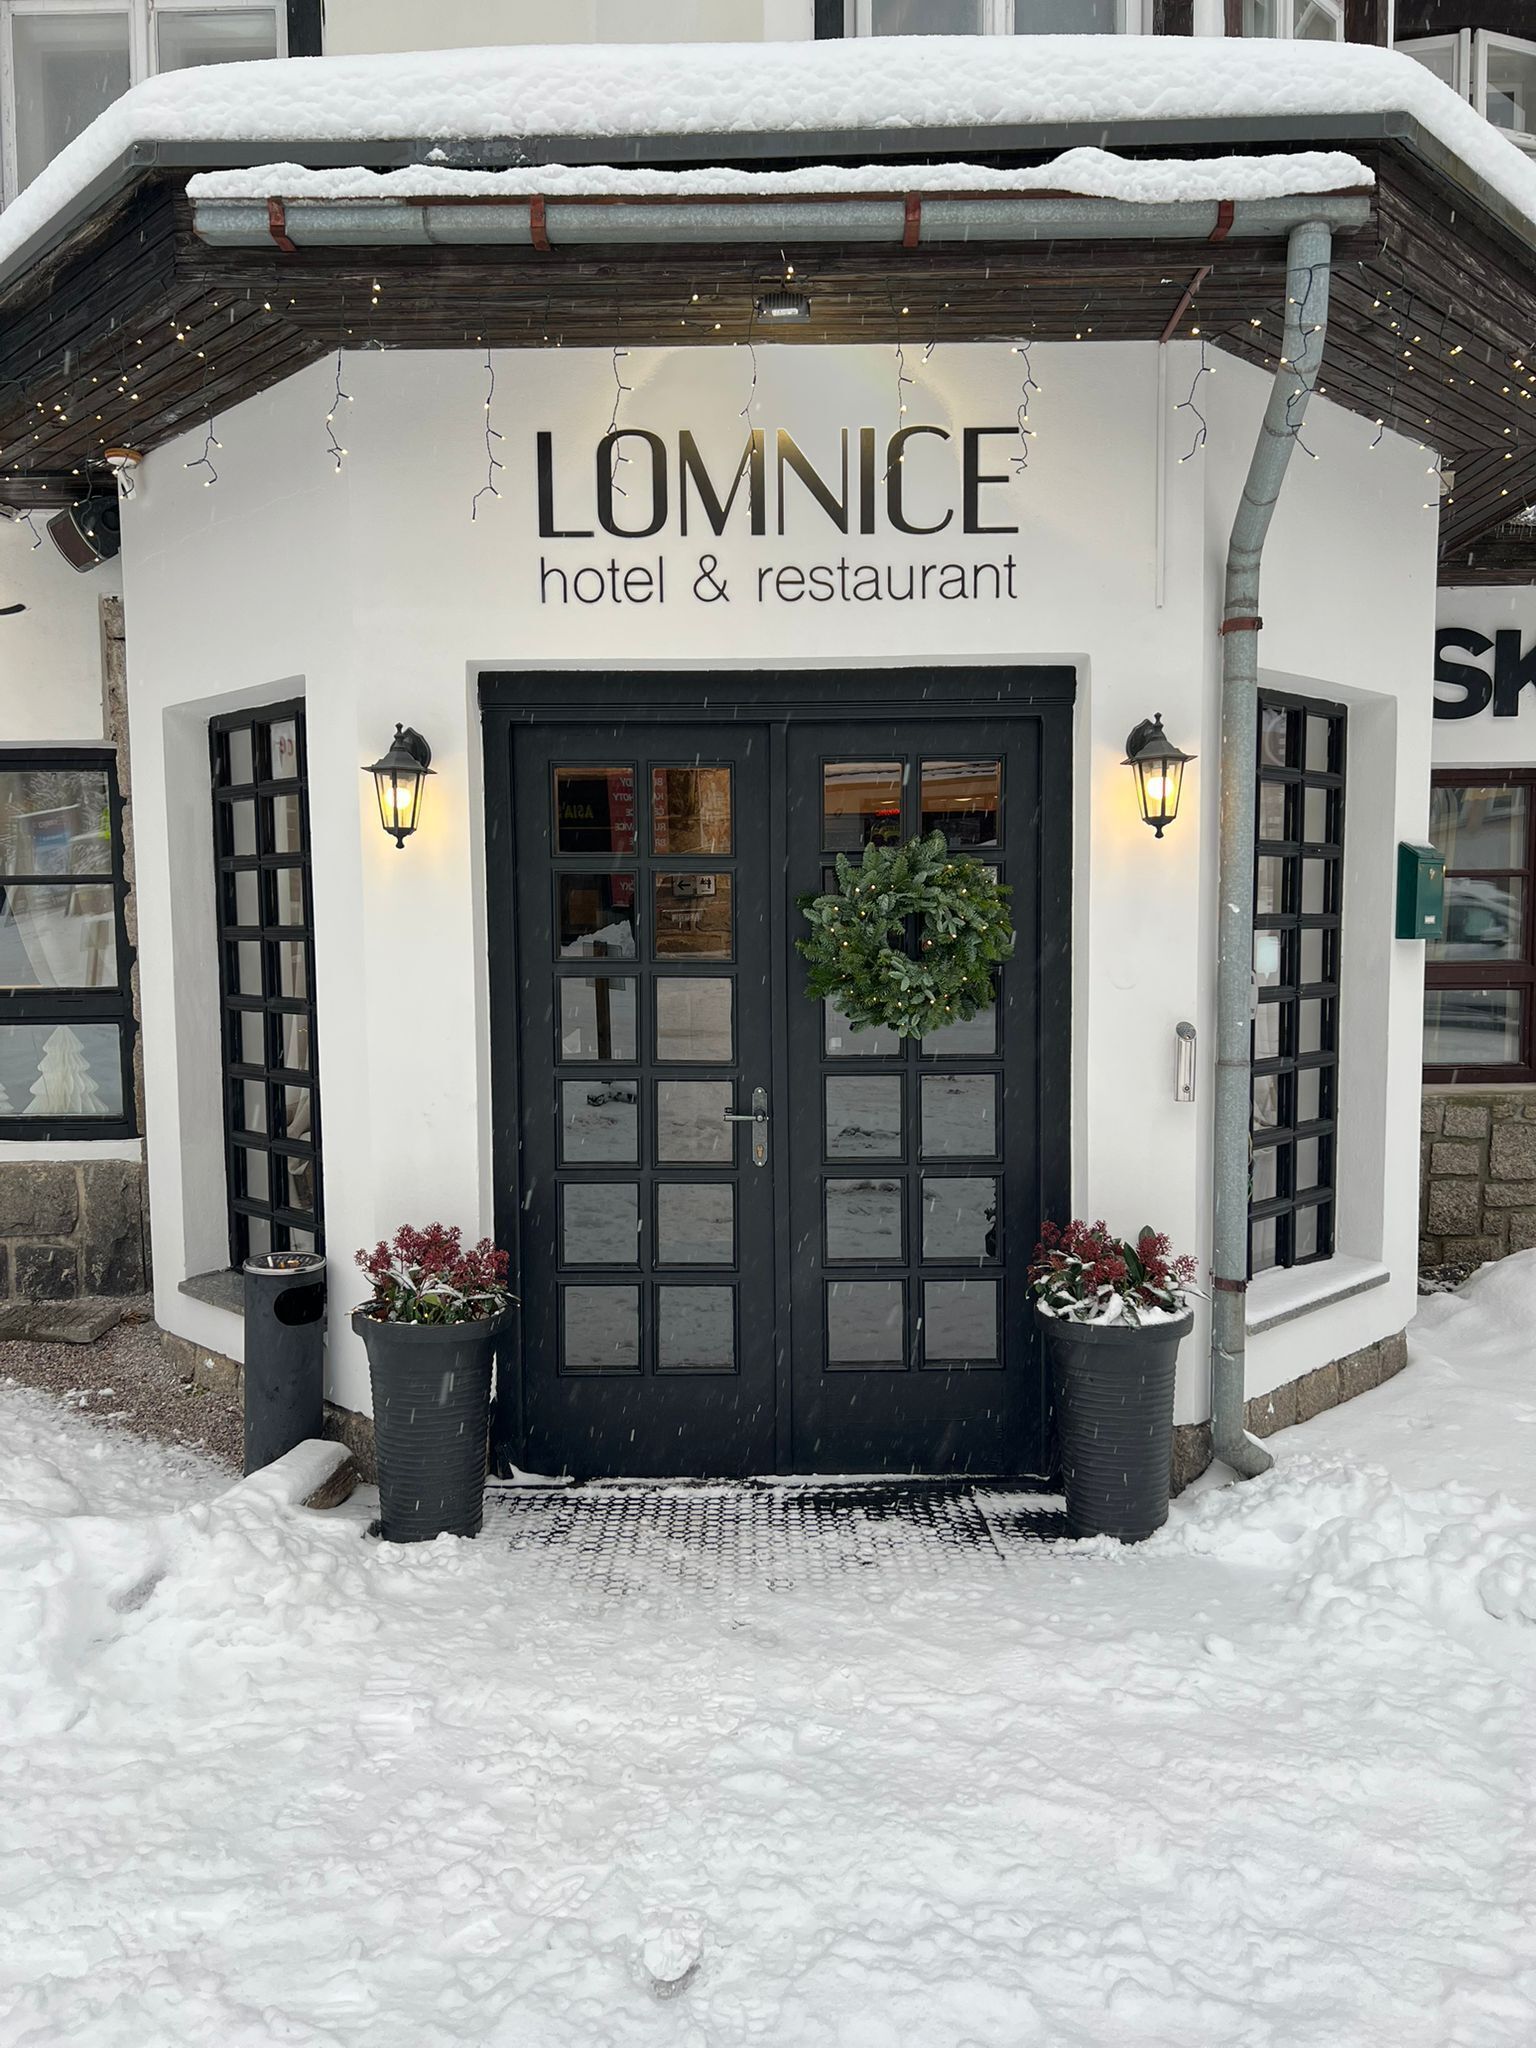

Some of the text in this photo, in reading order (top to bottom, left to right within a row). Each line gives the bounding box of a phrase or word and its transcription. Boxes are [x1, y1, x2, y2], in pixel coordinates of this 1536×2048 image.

[536, 426, 1019, 539] LOMNICE
[541, 554, 1018, 605] hotel & restaurant
